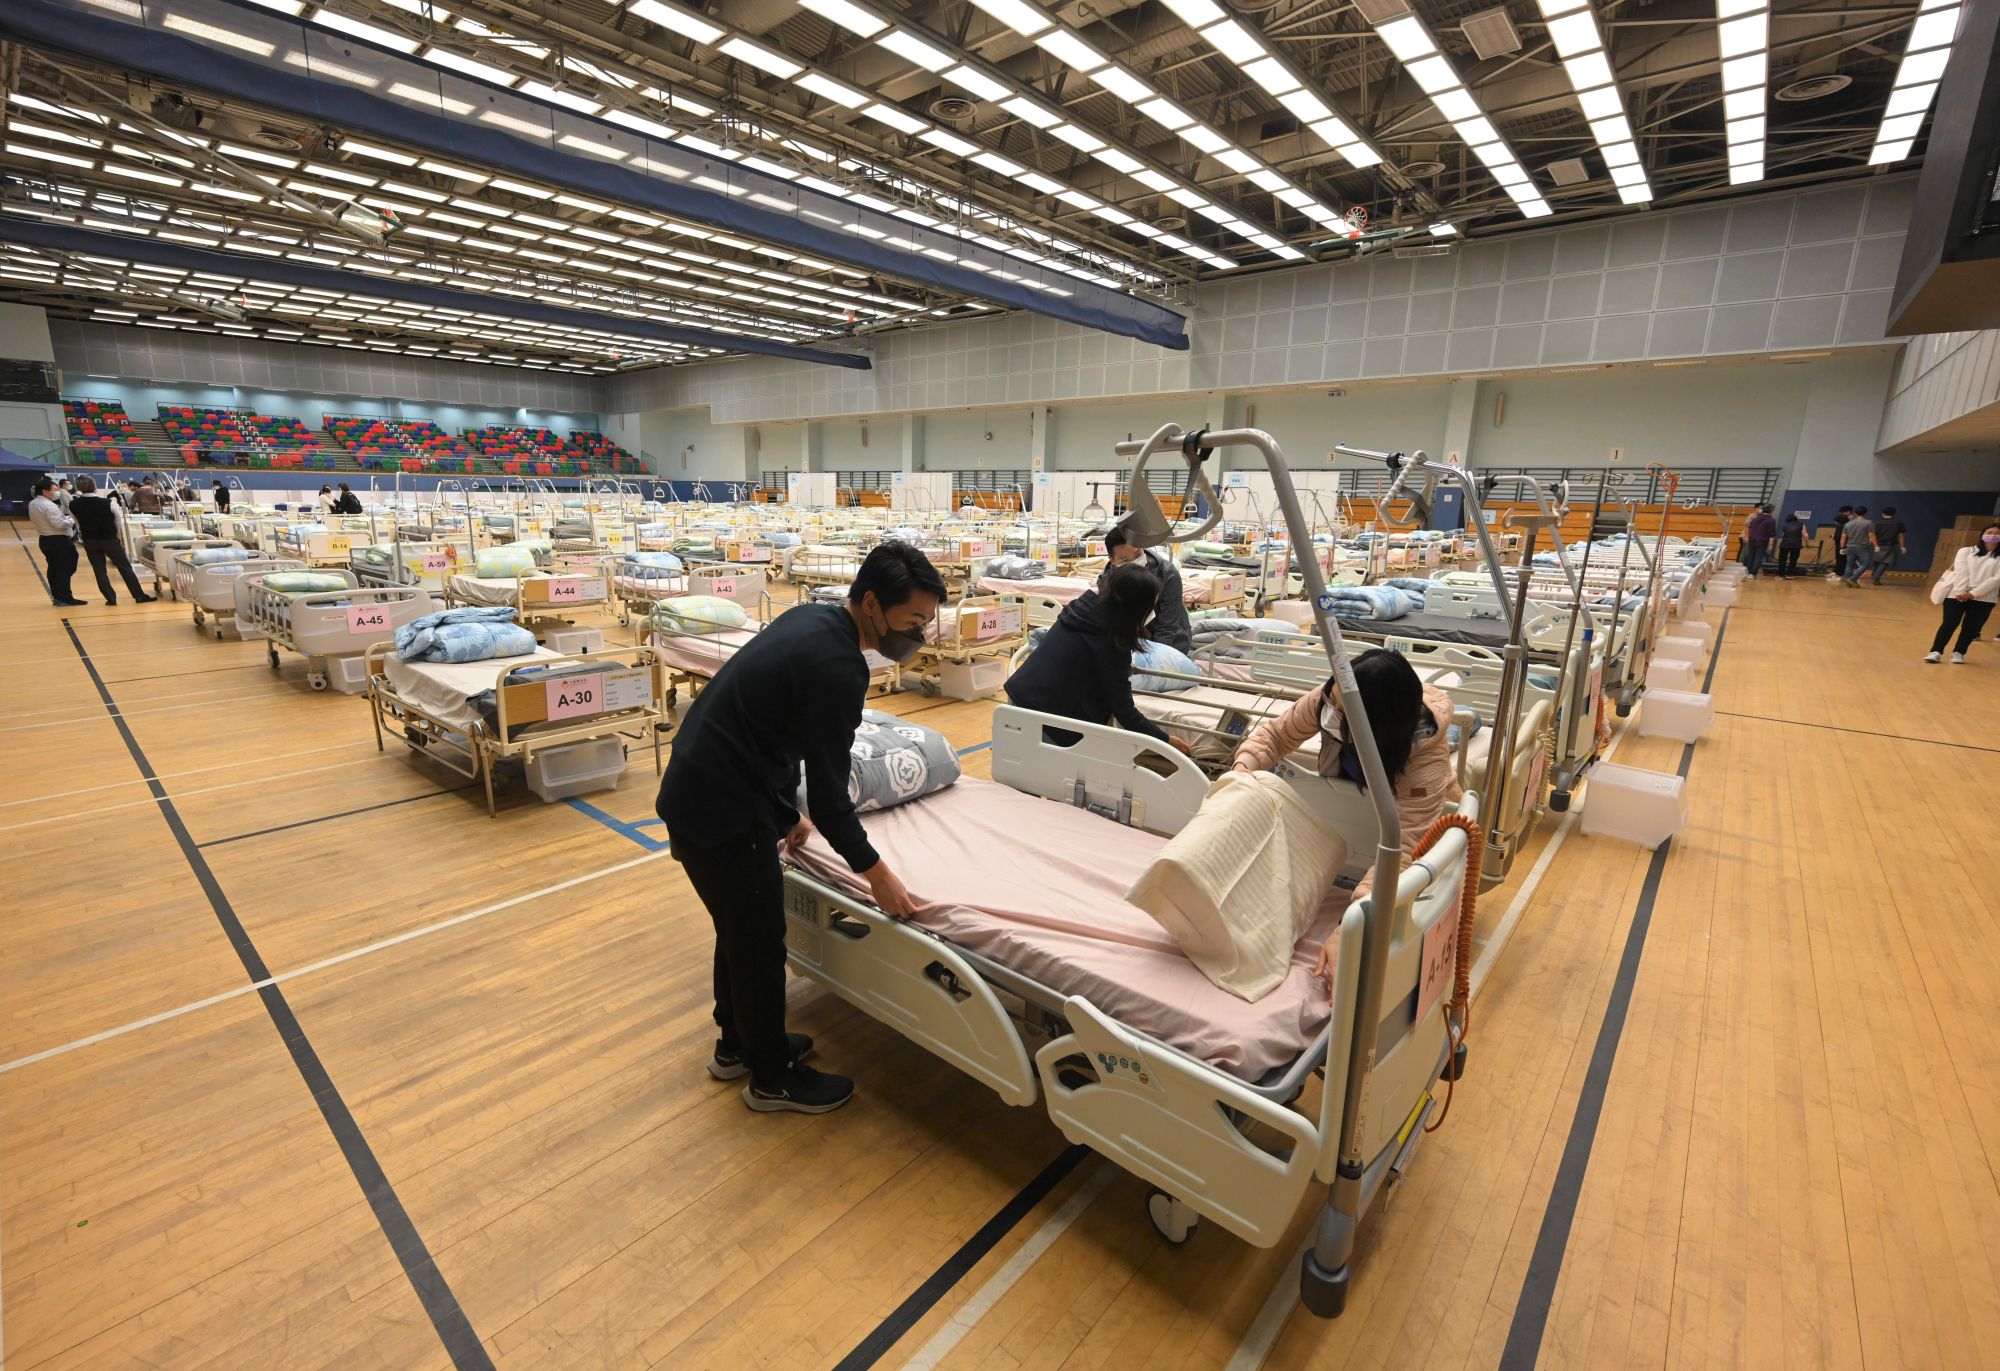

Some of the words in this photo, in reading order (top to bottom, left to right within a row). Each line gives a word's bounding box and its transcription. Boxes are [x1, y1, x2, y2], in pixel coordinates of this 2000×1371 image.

[1449, 453, 1458, 463] A
[555, 587, 575, 595] A-44
[716, 585, 733, 593] A-43
[356, 615, 384, 626] A-45
[981, 619, 997, 630] A-28
[557, 690, 593, 708] A-30
[1425, 933, 1453, 993] A-15
